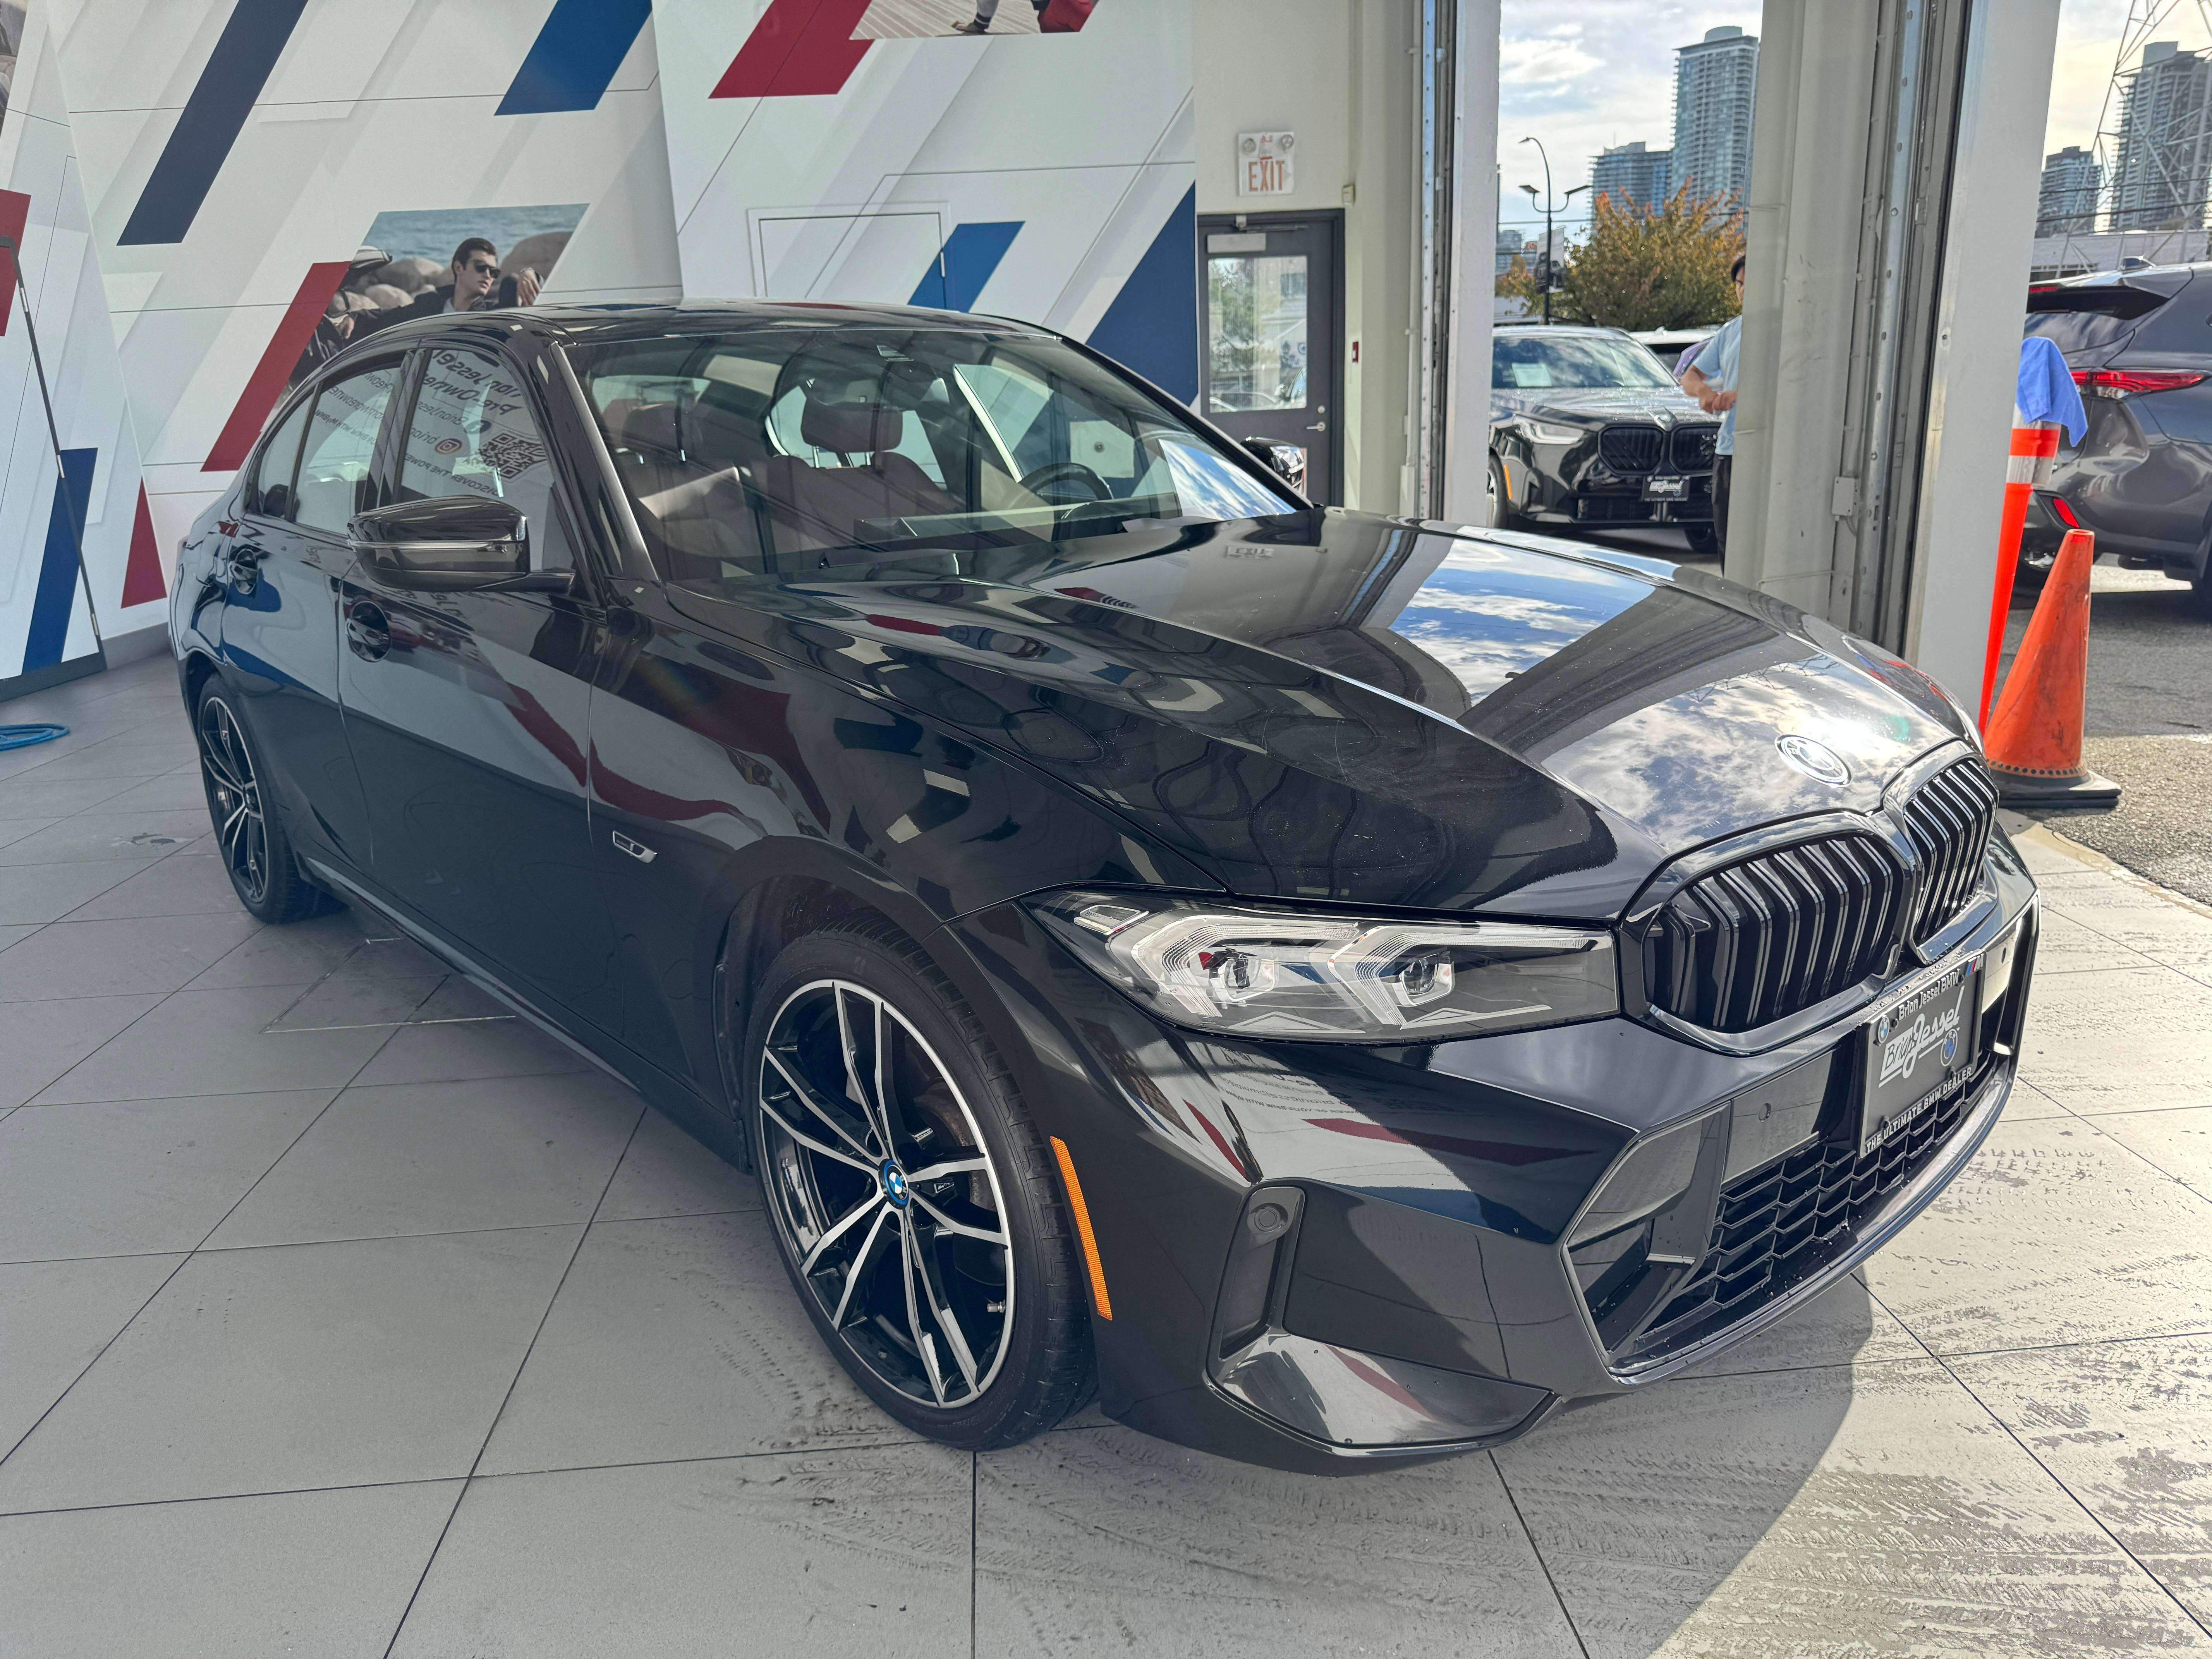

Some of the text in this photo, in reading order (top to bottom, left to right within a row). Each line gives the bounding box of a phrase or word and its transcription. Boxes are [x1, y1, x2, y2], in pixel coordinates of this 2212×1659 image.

[1249, 160, 1285, 191] EXIT
[1899, 998, 1918, 1021] Brian
[1919, 981, 1941, 1009] Jessel
[1941, 968, 1960, 992] BMW
[1902, 985, 1965, 1079] Jessel
[1866, 1066, 1972, 1154] THE ULTIMATE BMW DEALER
